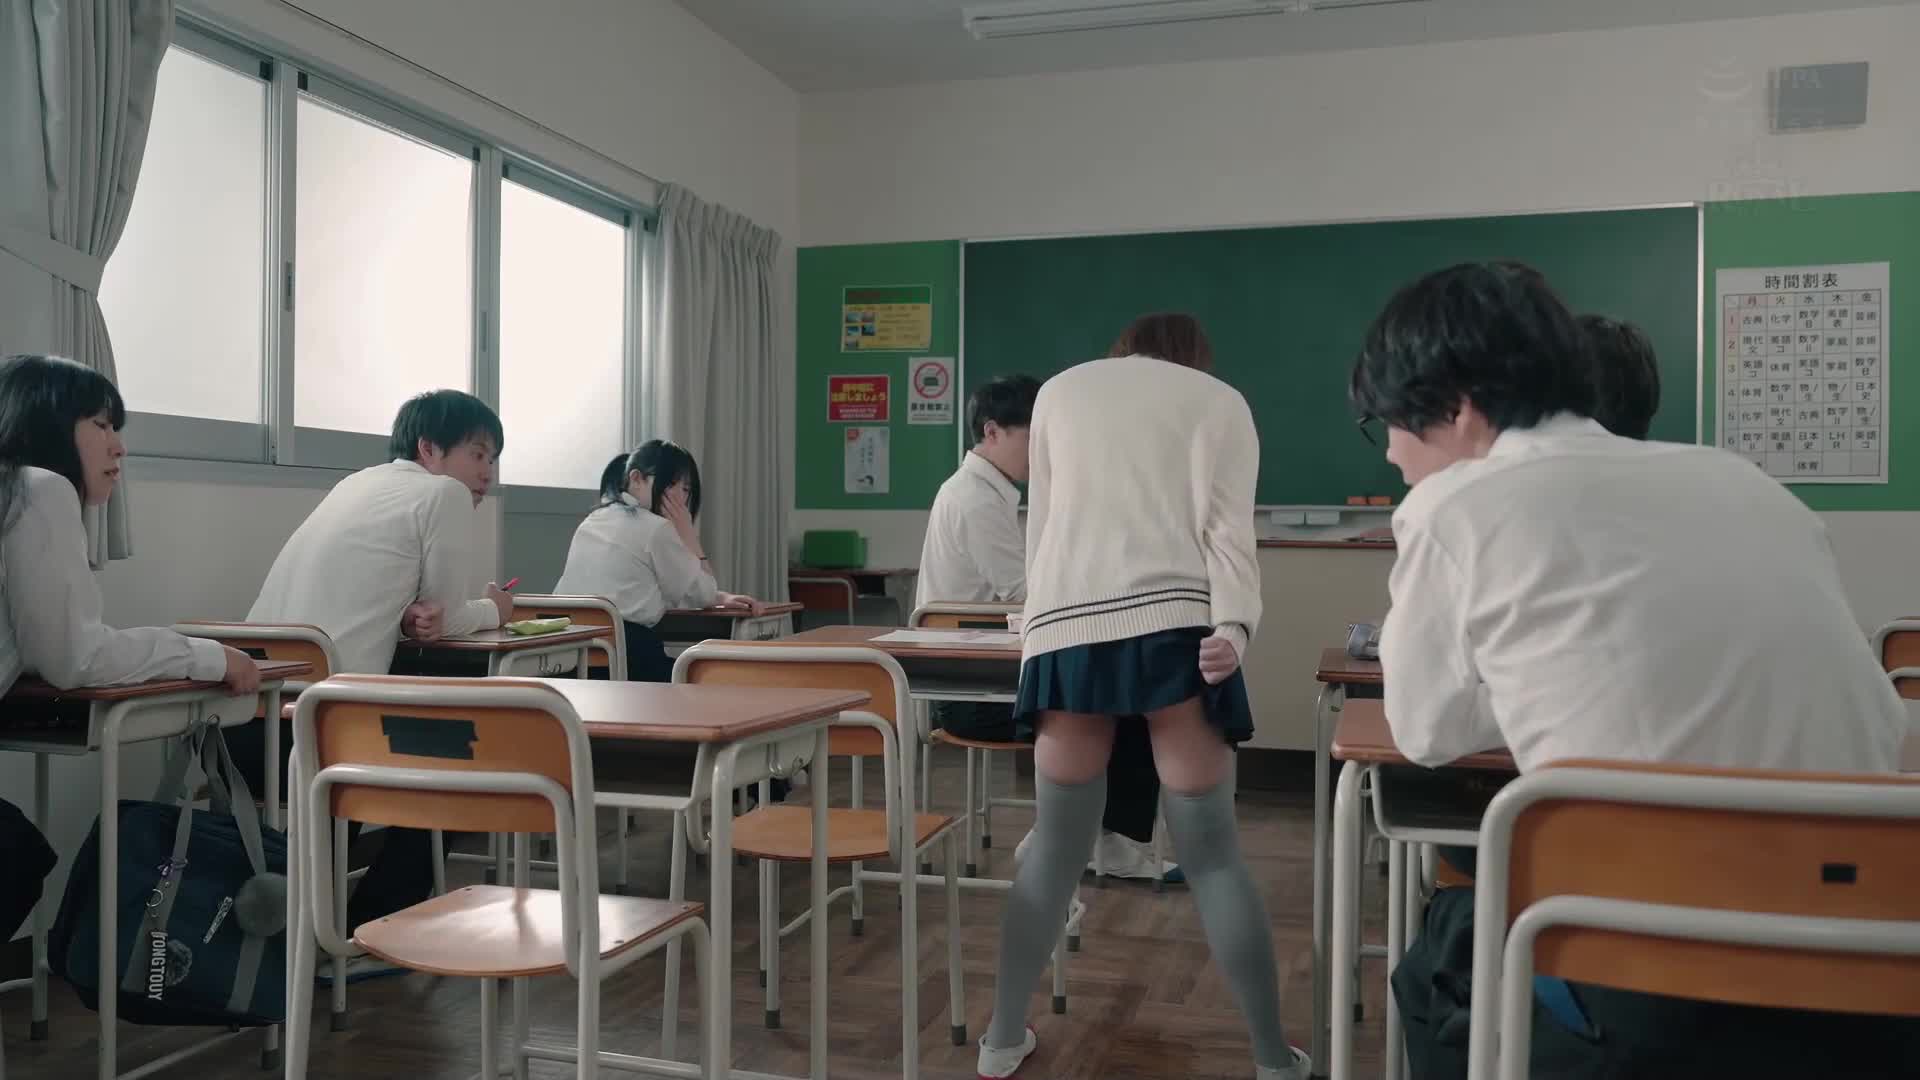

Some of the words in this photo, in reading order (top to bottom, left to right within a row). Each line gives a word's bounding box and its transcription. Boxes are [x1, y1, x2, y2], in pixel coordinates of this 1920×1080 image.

[1765, 273, 1839, 289] 時間割表
[1776, 296, 1785, 304] 火
[1771, 315, 1791, 324] 化学
[1856, 382, 1876, 390] 日本
